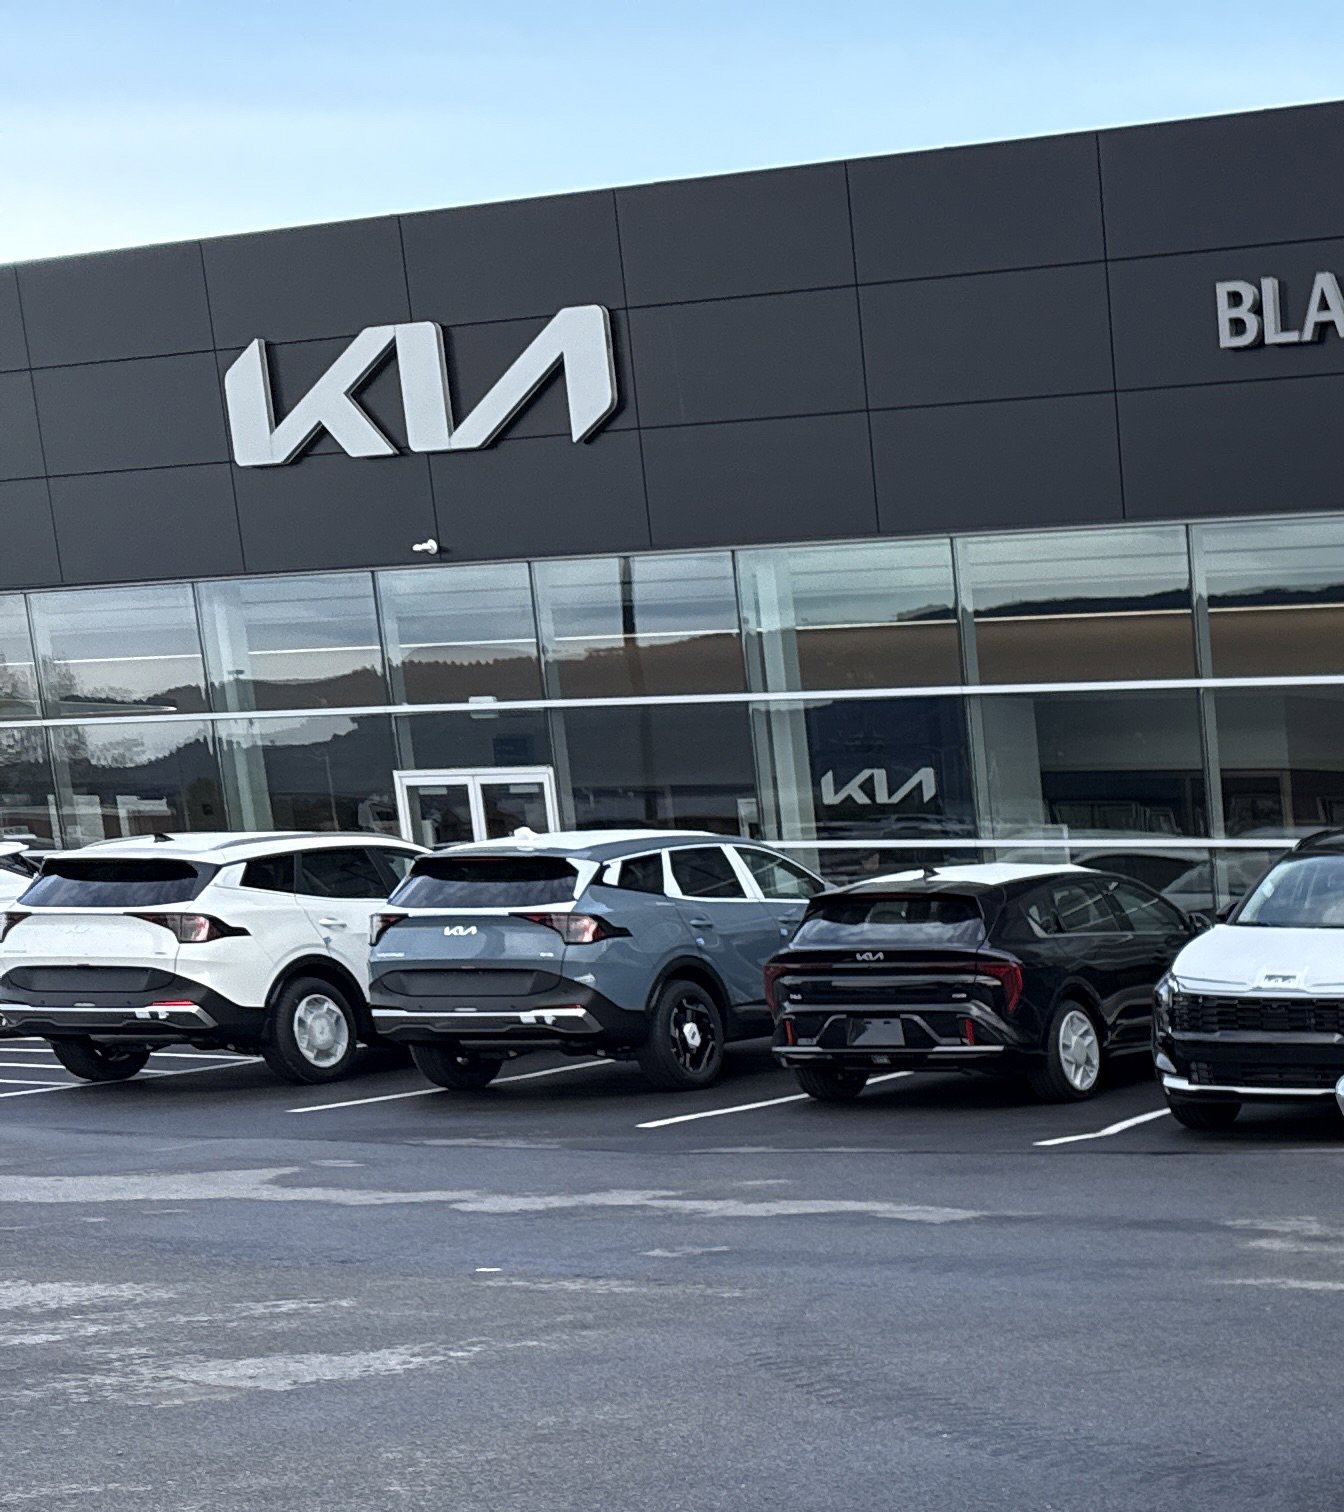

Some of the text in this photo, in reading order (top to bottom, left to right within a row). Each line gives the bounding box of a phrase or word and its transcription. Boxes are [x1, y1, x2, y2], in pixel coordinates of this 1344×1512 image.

[225, 304, 618, 467] KIA
[820, 766, 937, 805] KIA
[444, 925, 478, 936] KIA
[855, 952, 884, 961] KIA
